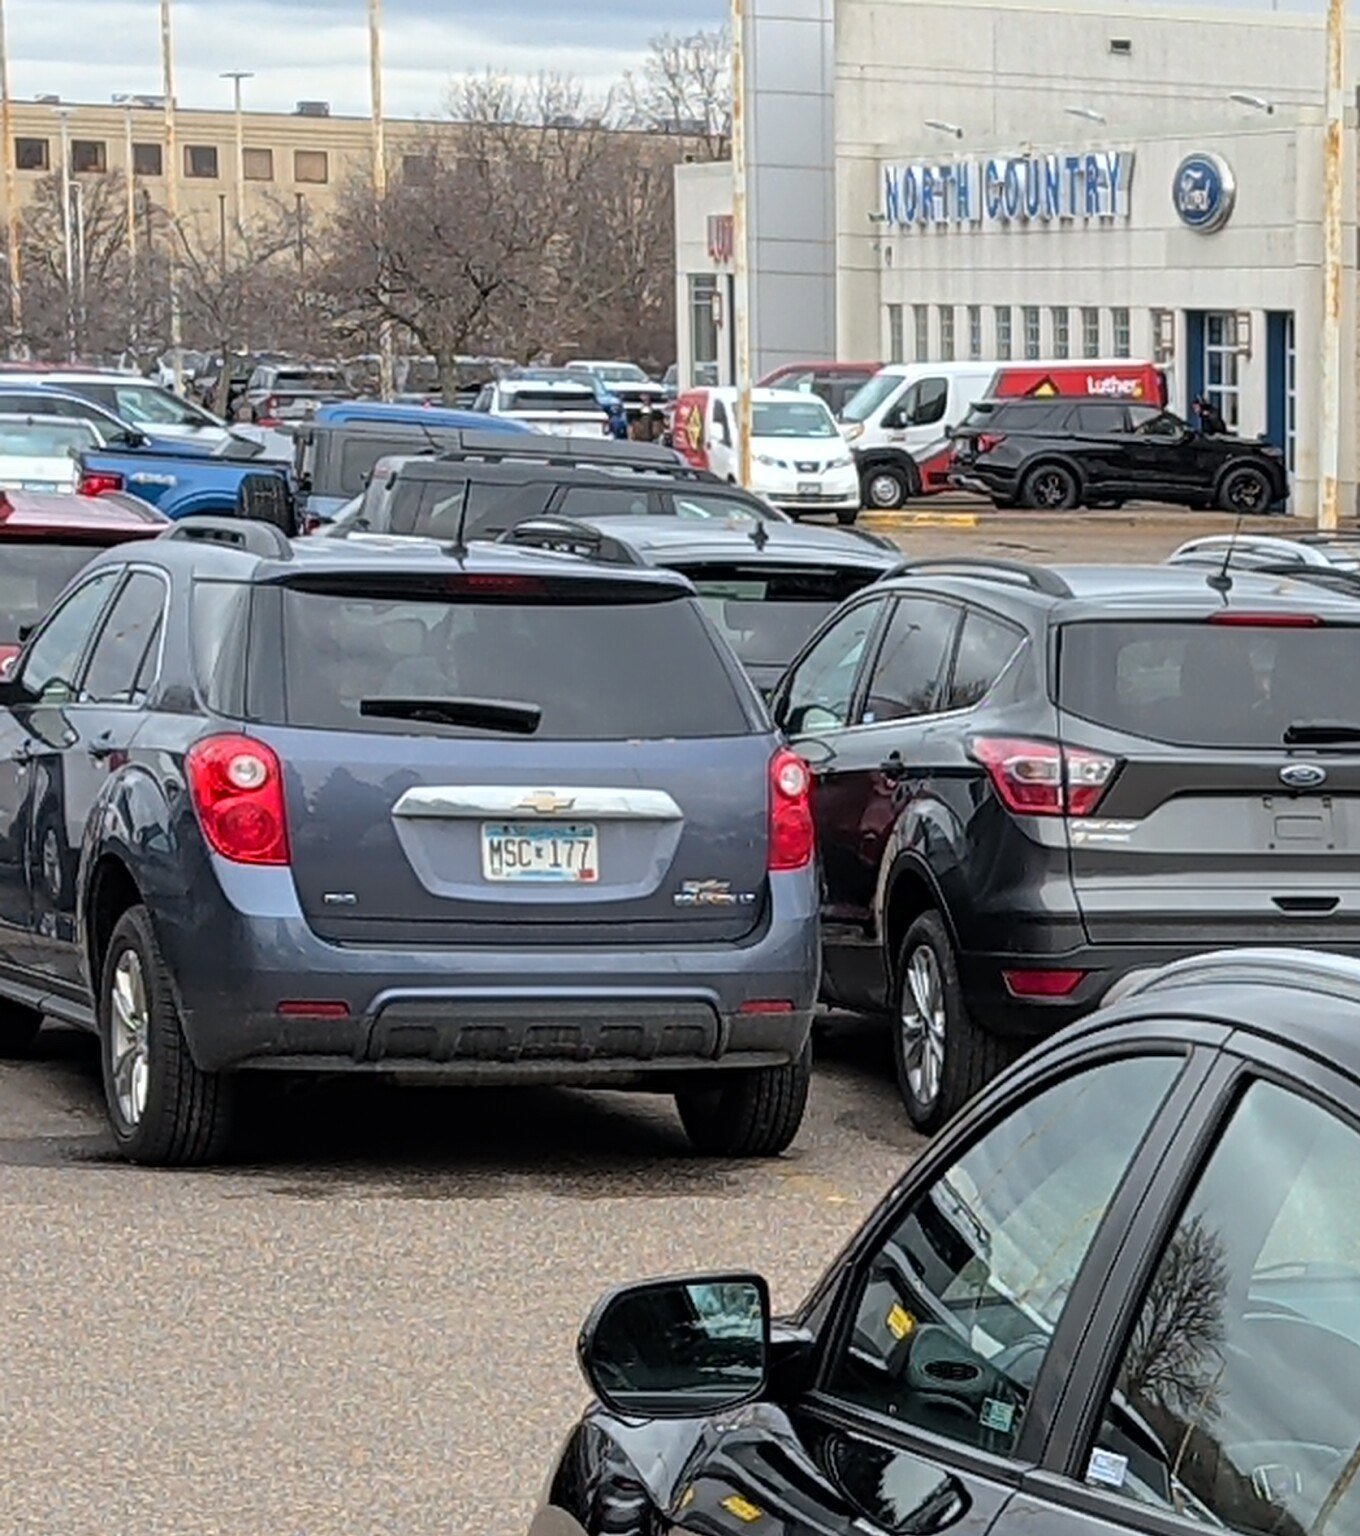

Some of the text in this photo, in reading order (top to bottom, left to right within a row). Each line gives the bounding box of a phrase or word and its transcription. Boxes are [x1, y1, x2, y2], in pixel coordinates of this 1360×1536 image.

[886, 151, 1124, 222] NORTH COUNTRY
[1179, 168, 1211, 211] Ford
